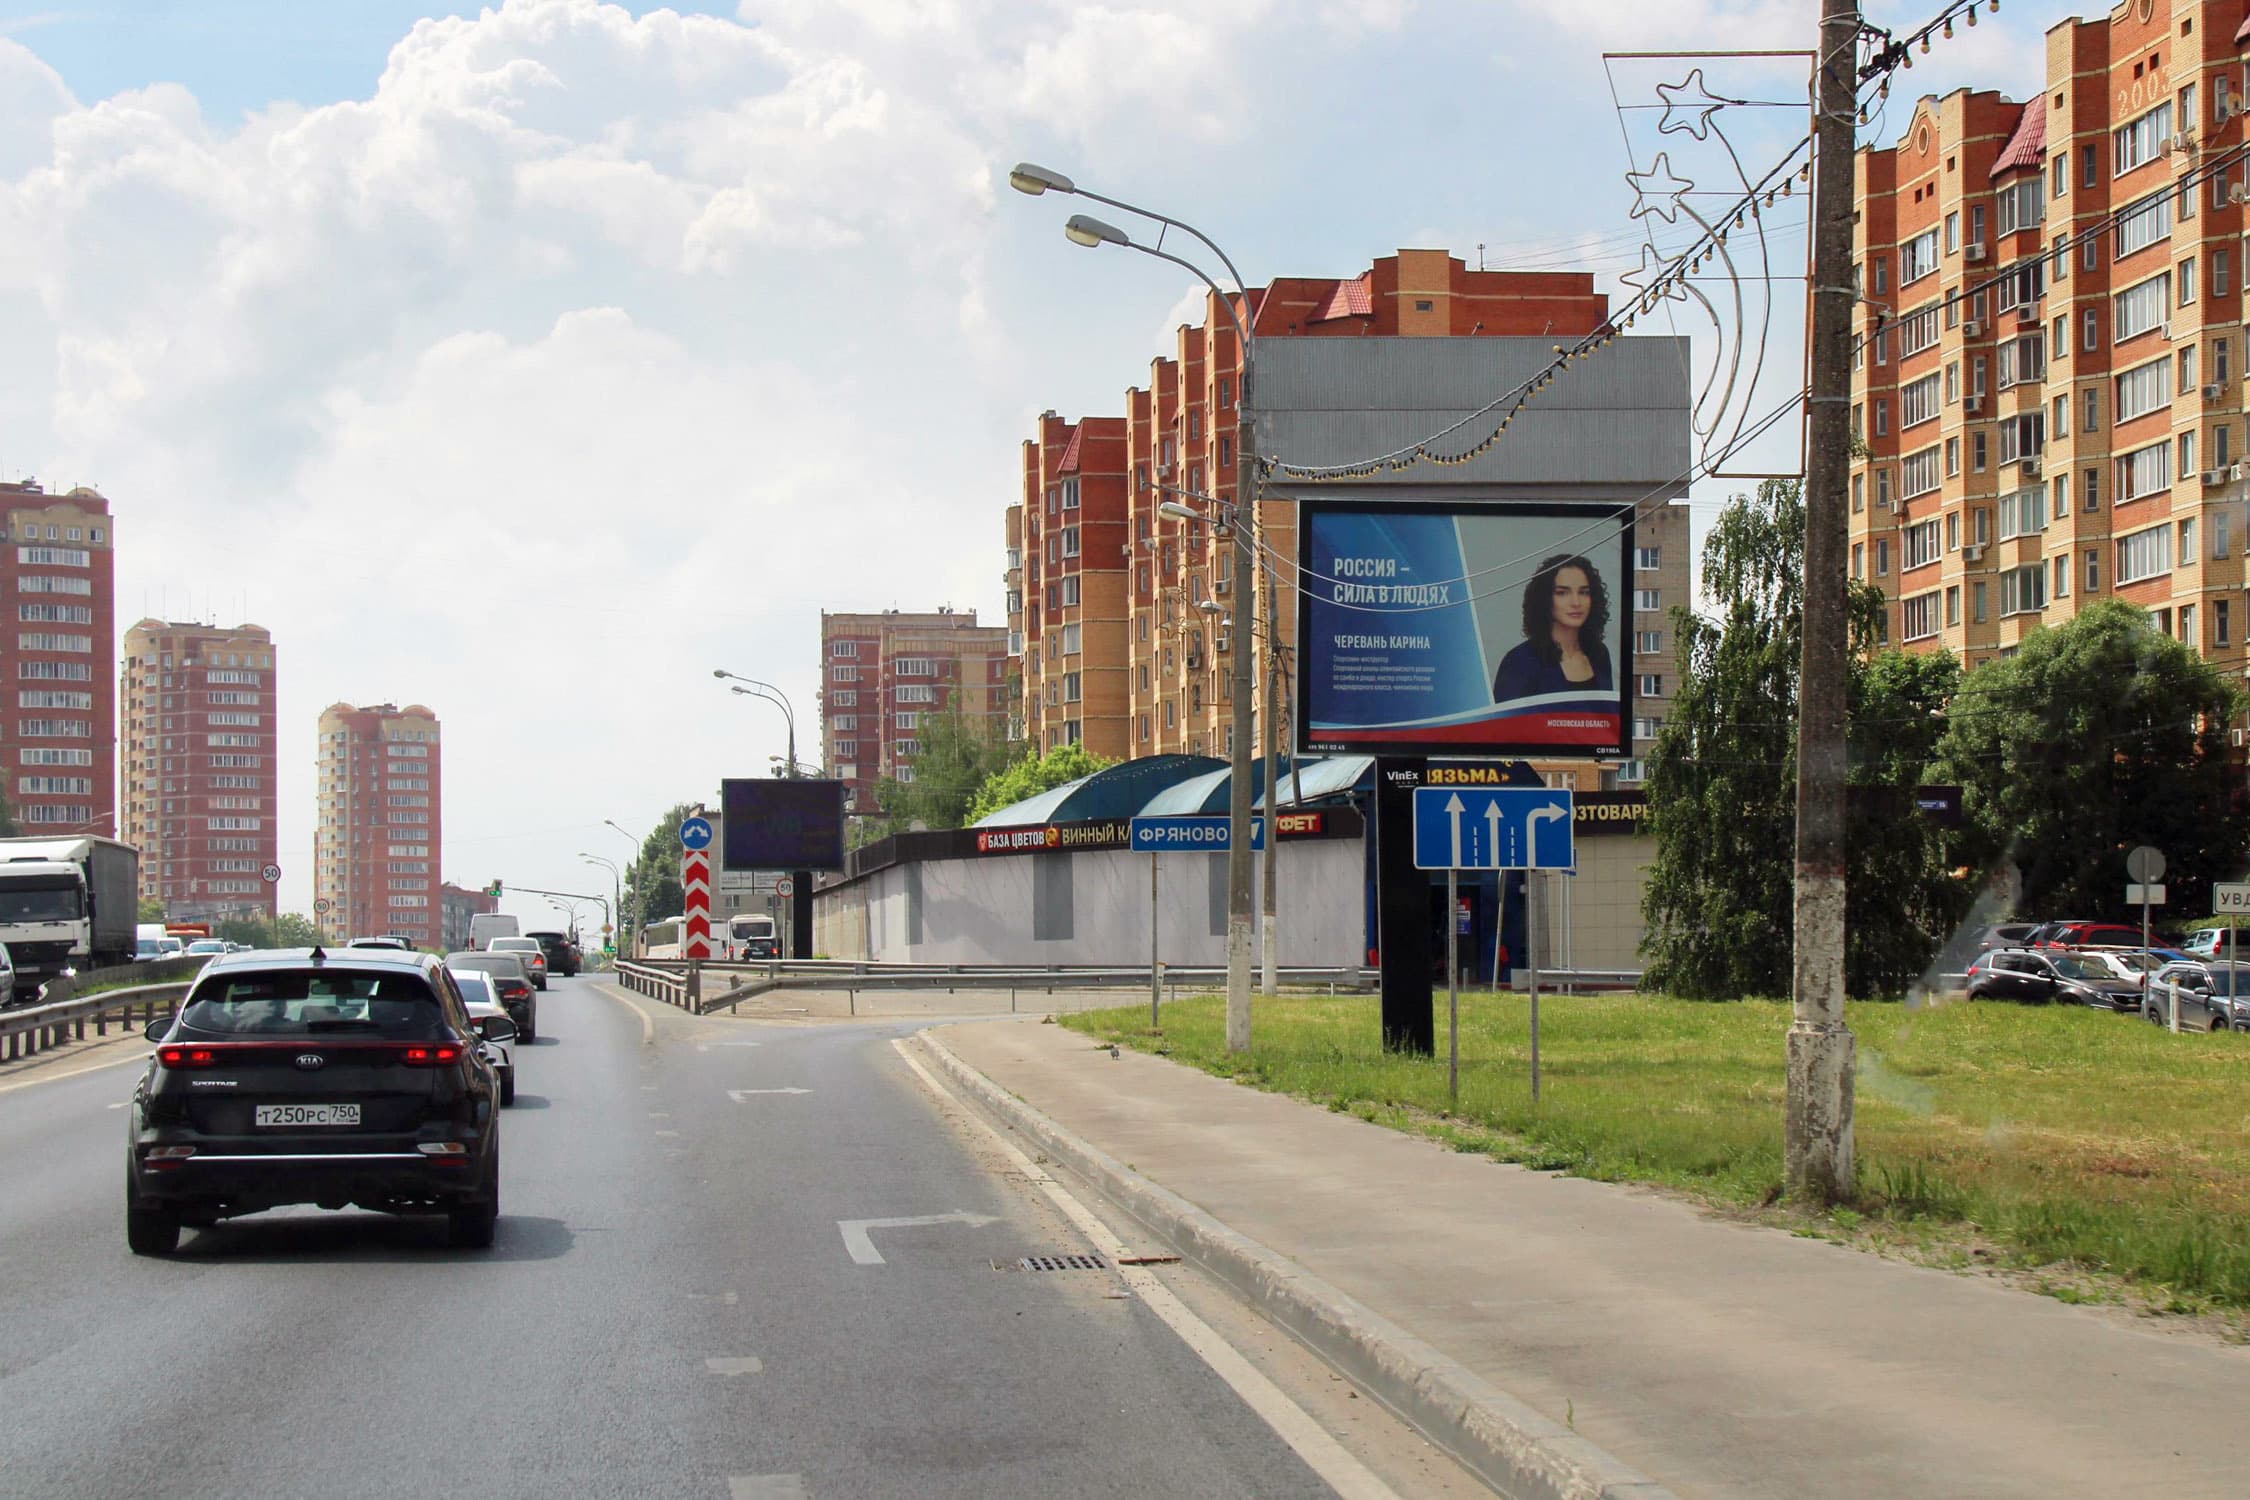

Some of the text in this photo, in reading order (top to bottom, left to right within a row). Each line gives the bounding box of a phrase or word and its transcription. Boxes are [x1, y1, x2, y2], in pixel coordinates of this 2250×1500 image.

[1334, 558, 1396, 577] РОССИЯ
[1334, 584, 1449, 606] СИЛА В ЛЮДЯХ
[1334, 635, 1431, 649] ЧЕРЕВАНЬ КАРИНА
[1547, 719, 1611, 728] МОСКОВСКАЯ ОБЛАСТЬ
[1386, 770, 1419, 781] VinEx
[1427, 768, 1510, 784] ЯЗЬМА»
[988, 831, 1045, 849] БАЗА ЦВЕТОВ
[1062, 823, 1115, 844] ВИННЫЙ
[1139, 827, 1228, 843] ФРЯНОВО
[264, 868, 278, 878] 50
[780, 883, 792, 892] 50
[262, 1105, 356, 1123] Т250РС 750
